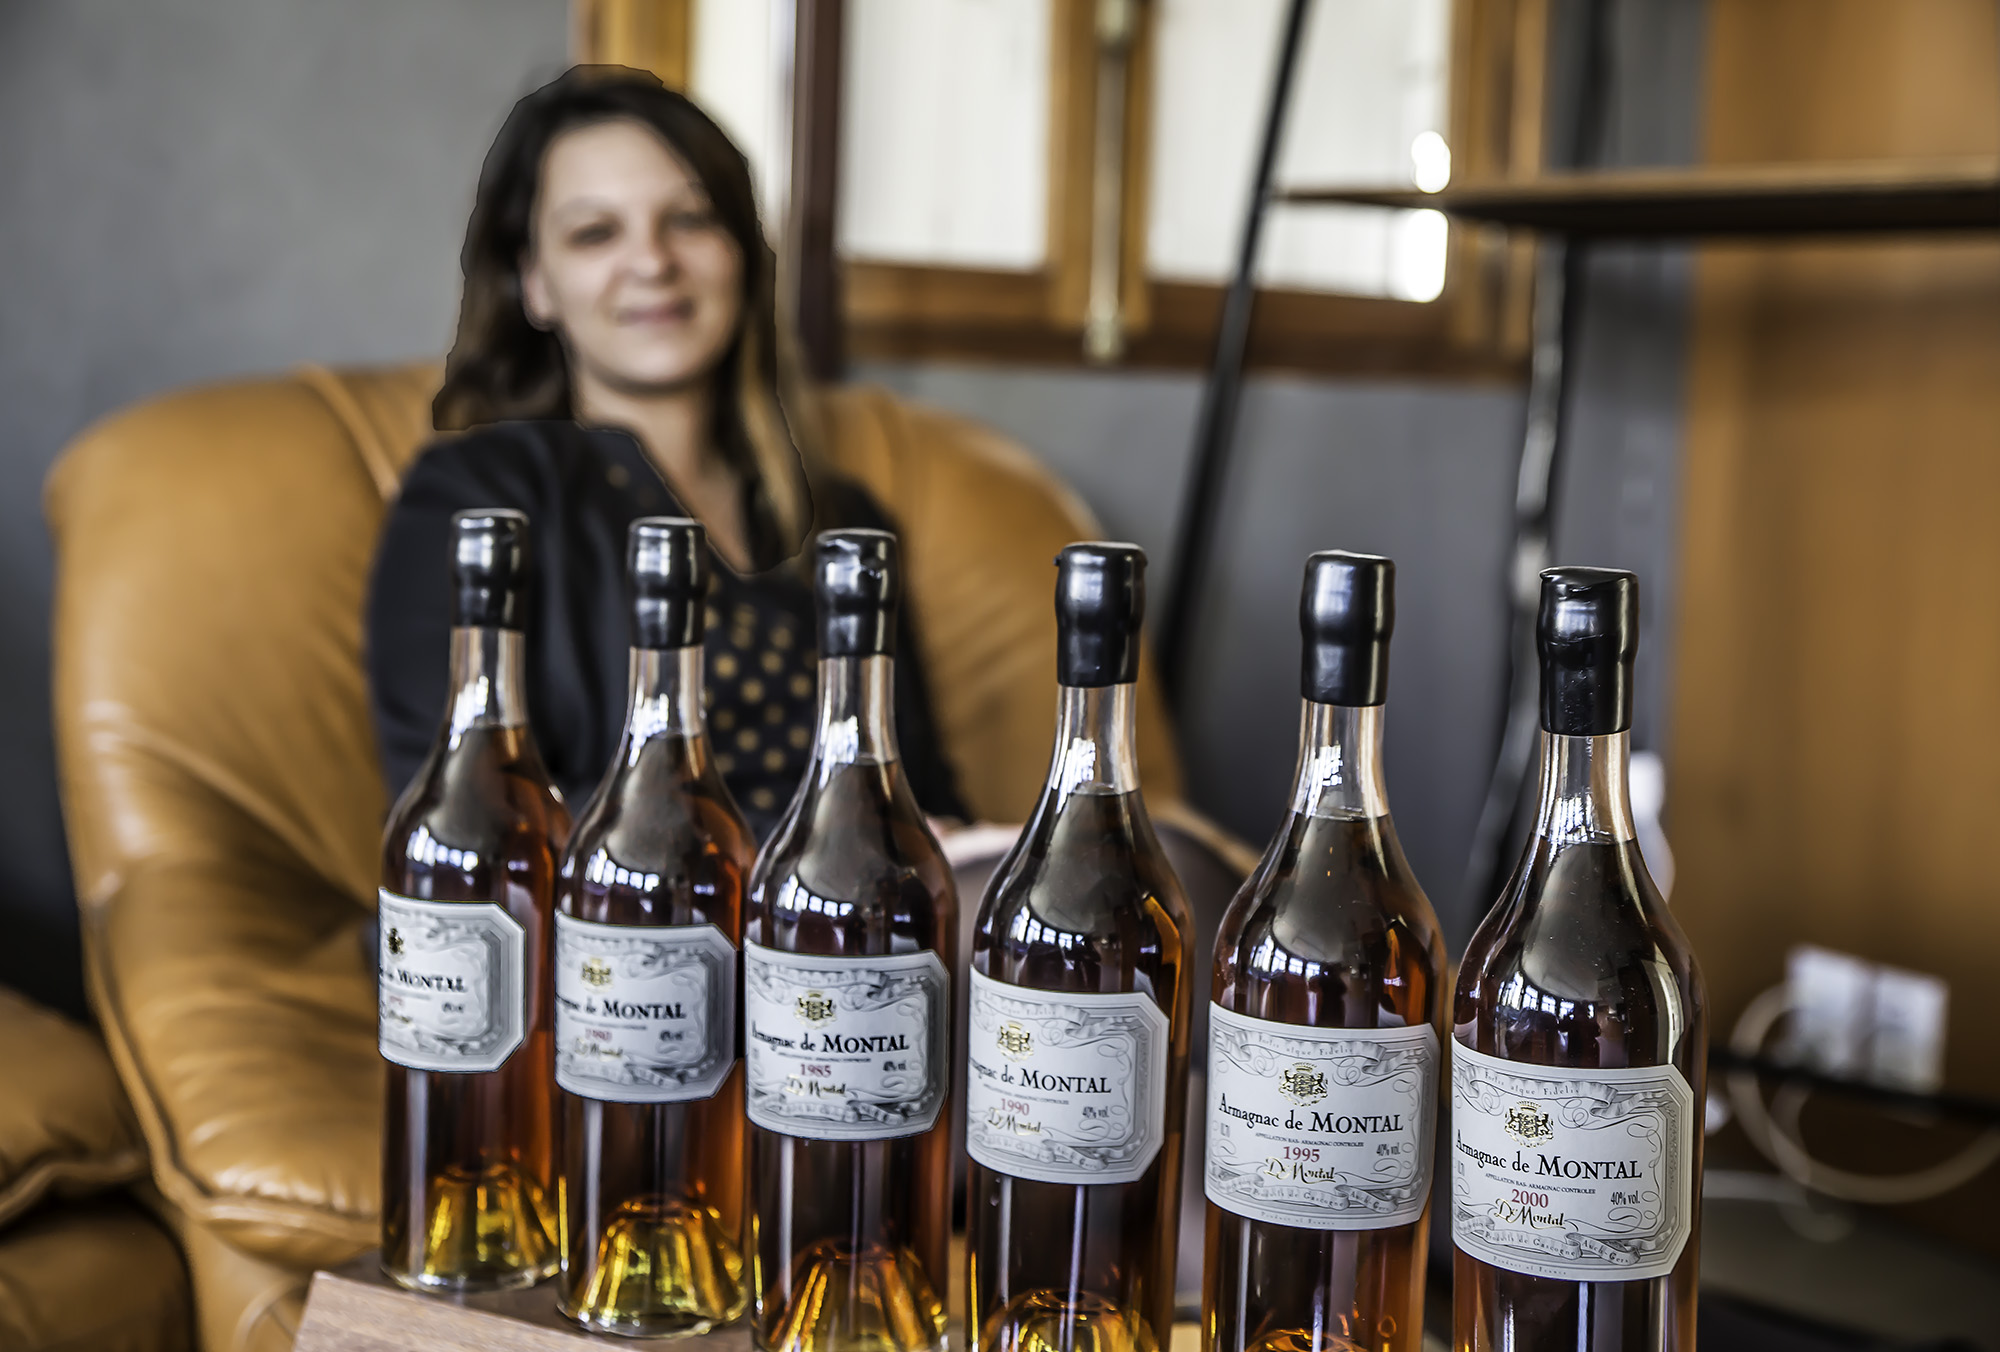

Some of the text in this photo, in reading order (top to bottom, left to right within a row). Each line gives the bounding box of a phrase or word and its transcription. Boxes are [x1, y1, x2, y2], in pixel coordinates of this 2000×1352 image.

[602, 999, 687, 1019] MONTAL
[800, 1032, 816, 1051] de
[822, 1034, 910, 1053] MONTAL
[801, 1064, 832, 1078] 1985
[1001, 1064, 1015, 1085] de
[1019, 1068, 1112, 1094] MONTAL
[1543, 1084, 1580, 1096] Fidelis
[1001, 1098, 1030, 1116] 1990
[1219, 1093, 1404, 1134] Armagnac de MONTAL
[1301, 1139, 1333, 1147] ARMAGNAC
[1283, 1145, 1321, 1163] 1995
[1455, 1129, 1507, 1169] Armagnac
[1512, 1150, 1530, 1173] de
[1535, 1153, 1643, 1180] MONTAL
[1292, 1162, 1337, 1185] Montal
[1485, 1172, 1515, 1185] APPELLATION
[1529, 1183, 1560, 1193] ARMAGNAC
[1511, 1188, 1549, 1208] 2000
[1610, 1191, 1627, 1206] 40%
[1516, 1206, 1567, 1230] Montal
[1532, 1238, 1576, 1257] Gascogne
